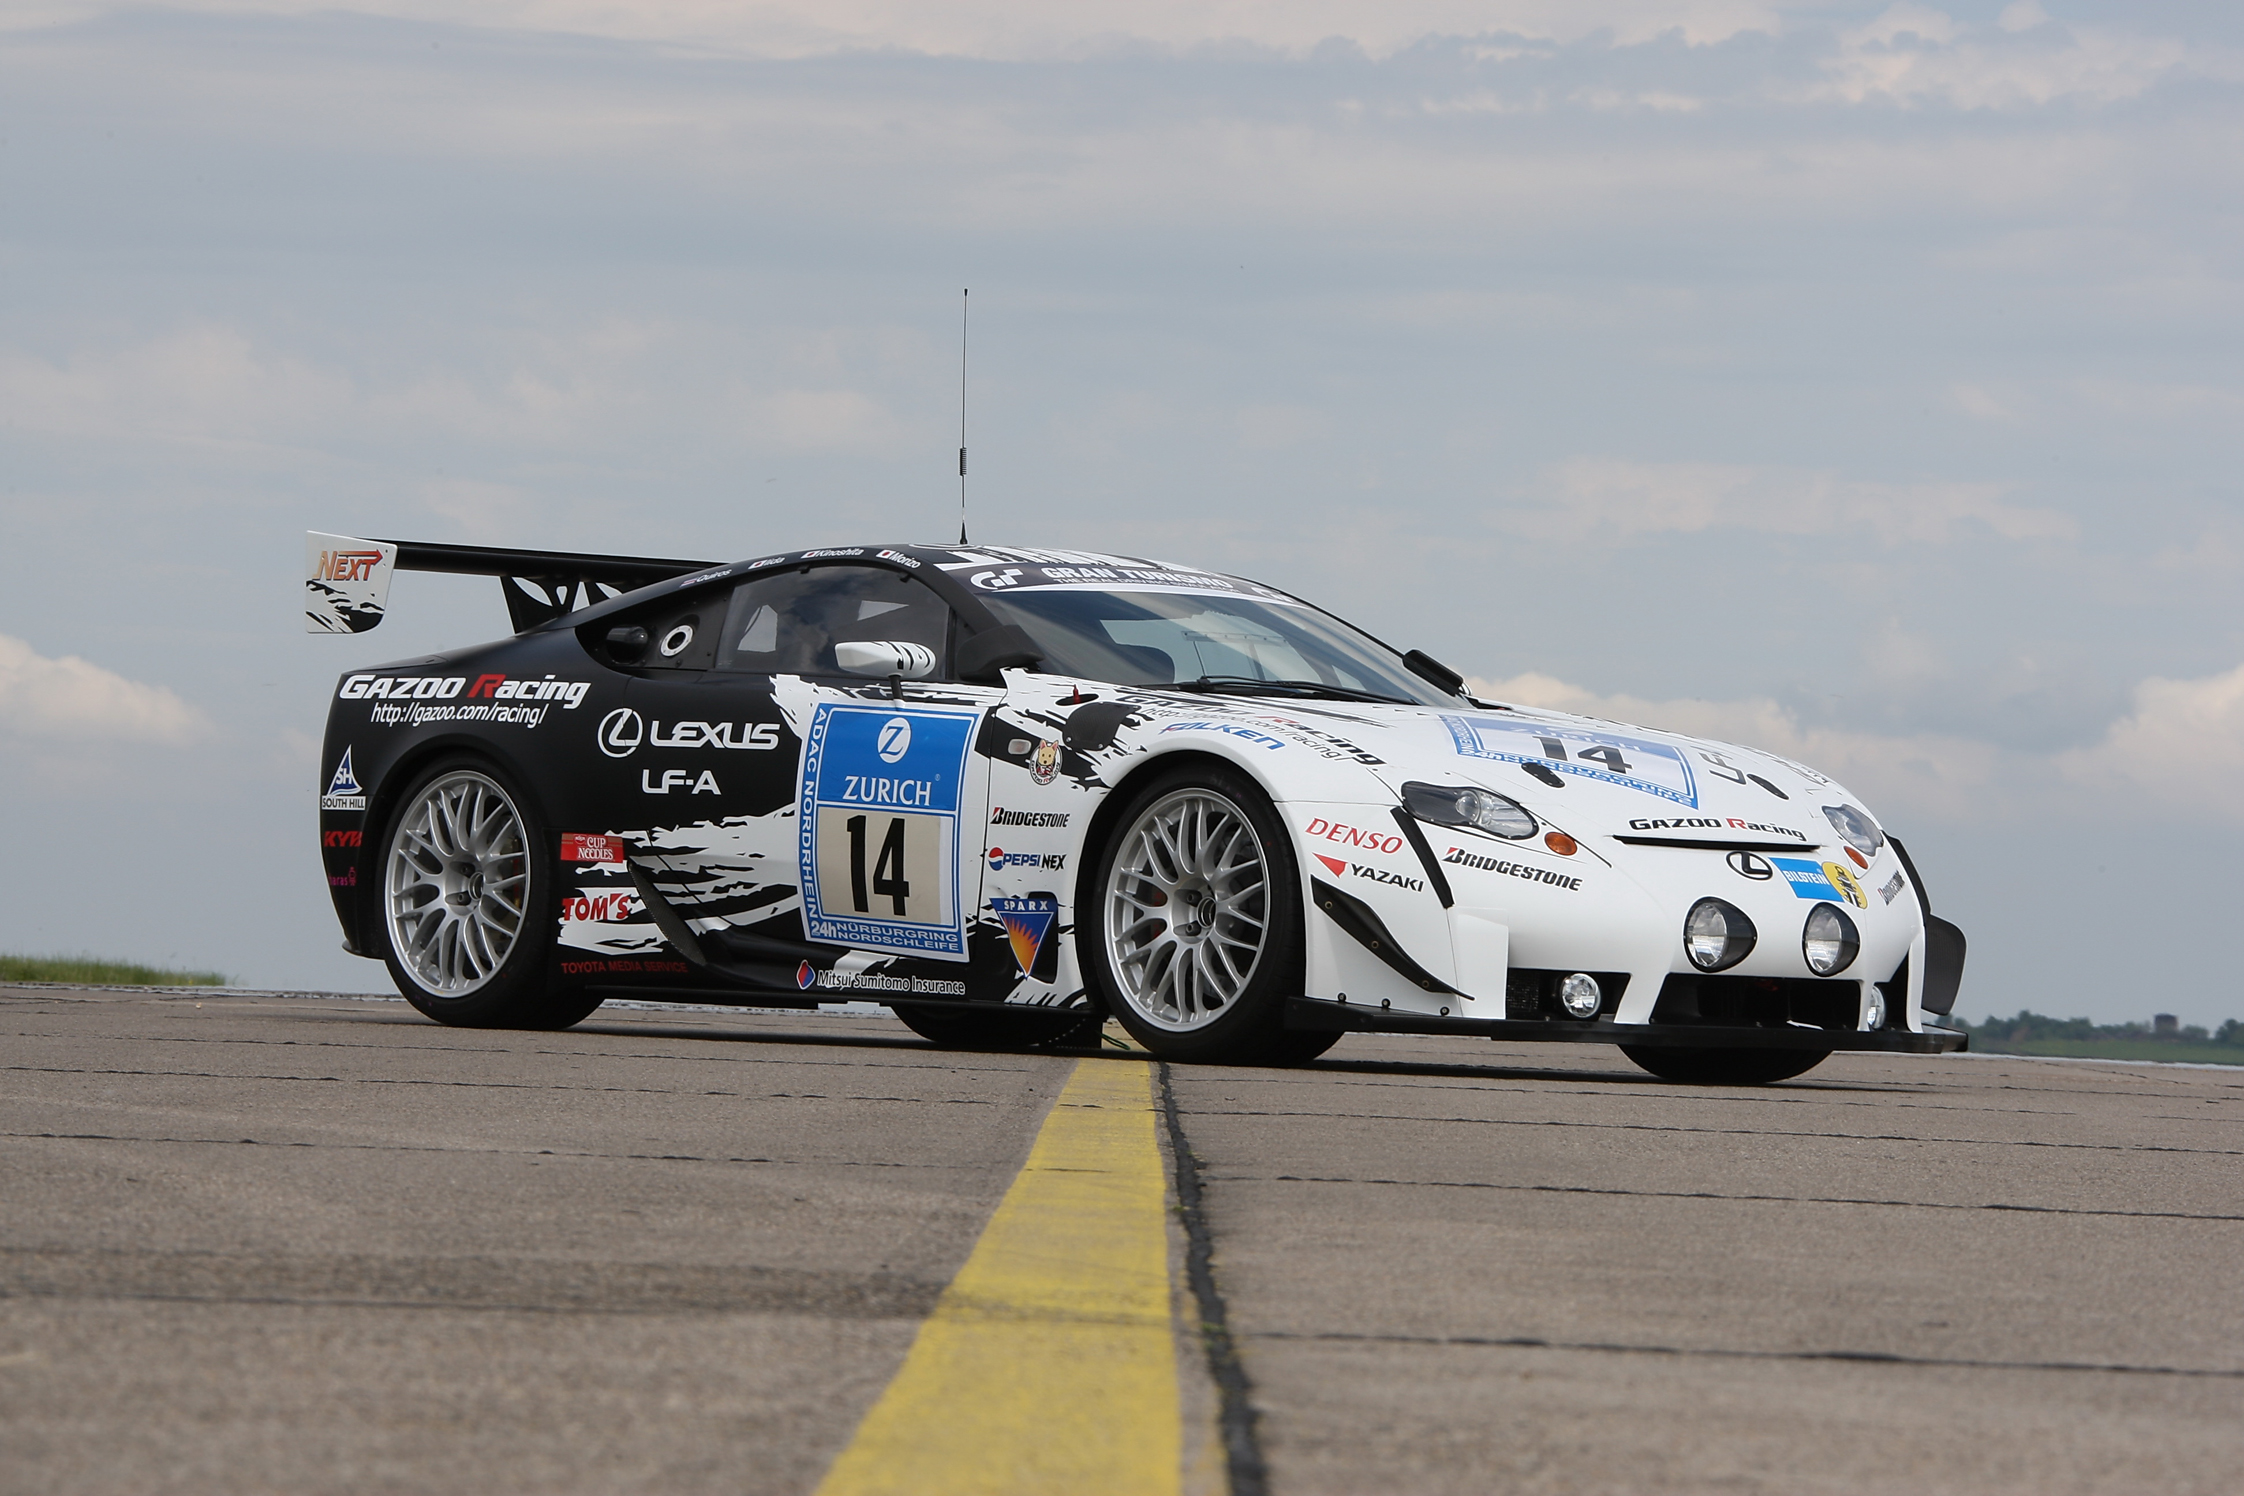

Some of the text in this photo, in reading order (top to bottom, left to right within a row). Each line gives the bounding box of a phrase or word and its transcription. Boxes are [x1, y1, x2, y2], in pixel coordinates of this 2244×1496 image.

[312, 550, 380, 581] NEXT
[889, 552, 921, 569] Morizo
[697, 569, 732, 582] Quiros
[1040, 567, 1234, 589] GRAN TURISMO
[340, 673, 591, 709] GAZOO Racing
[370, 701, 549, 729] http://gazoo.com/racing/
[650, 720, 780, 750] LEXUS
[1158, 721, 1286, 750] FALKEN
[1256, 715, 1387, 766] Racing
[1532, 736, 1632, 774] 14
[335, 767, 353, 785] SH
[641, 769, 721, 795] LF-A
[322, 797, 364, 809] SOUTH HILL
[842, 775, 932, 806] ZURICH
[801, 708, 827, 919] ADAC NORDRHEIN
[990, 807, 1070, 827] BRIDGESTONE
[587, 837, 606, 848] CUP
[1305, 817, 1403, 854] DENSO
[1629, 818, 1807, 842] GAZOO Racing
[578, 847, 613, 860] NOODLES
[846, 814, 910, 917] 14
[1003, 853, 1067, 872] PEPSI NEX
[1351, 863, 1425, 893] YAZAKI
[1441, 846, 1583, 892] BRIDGESTONE
[1782, 870, 1830, 885] BILSTEIN
[562, 893, 630, 921] TOM'S
[811, 920, 837, 938] 24h
[836, 922, 958, 942] NÜRBURGRING
[838, 932, 959, 951] NORDSCHLEIFE
[561, 961, 688, 974] TOYOTA MEDIA SERVICE
[817, 970, 966, 995] Mitsui Sumitomo Insurance
